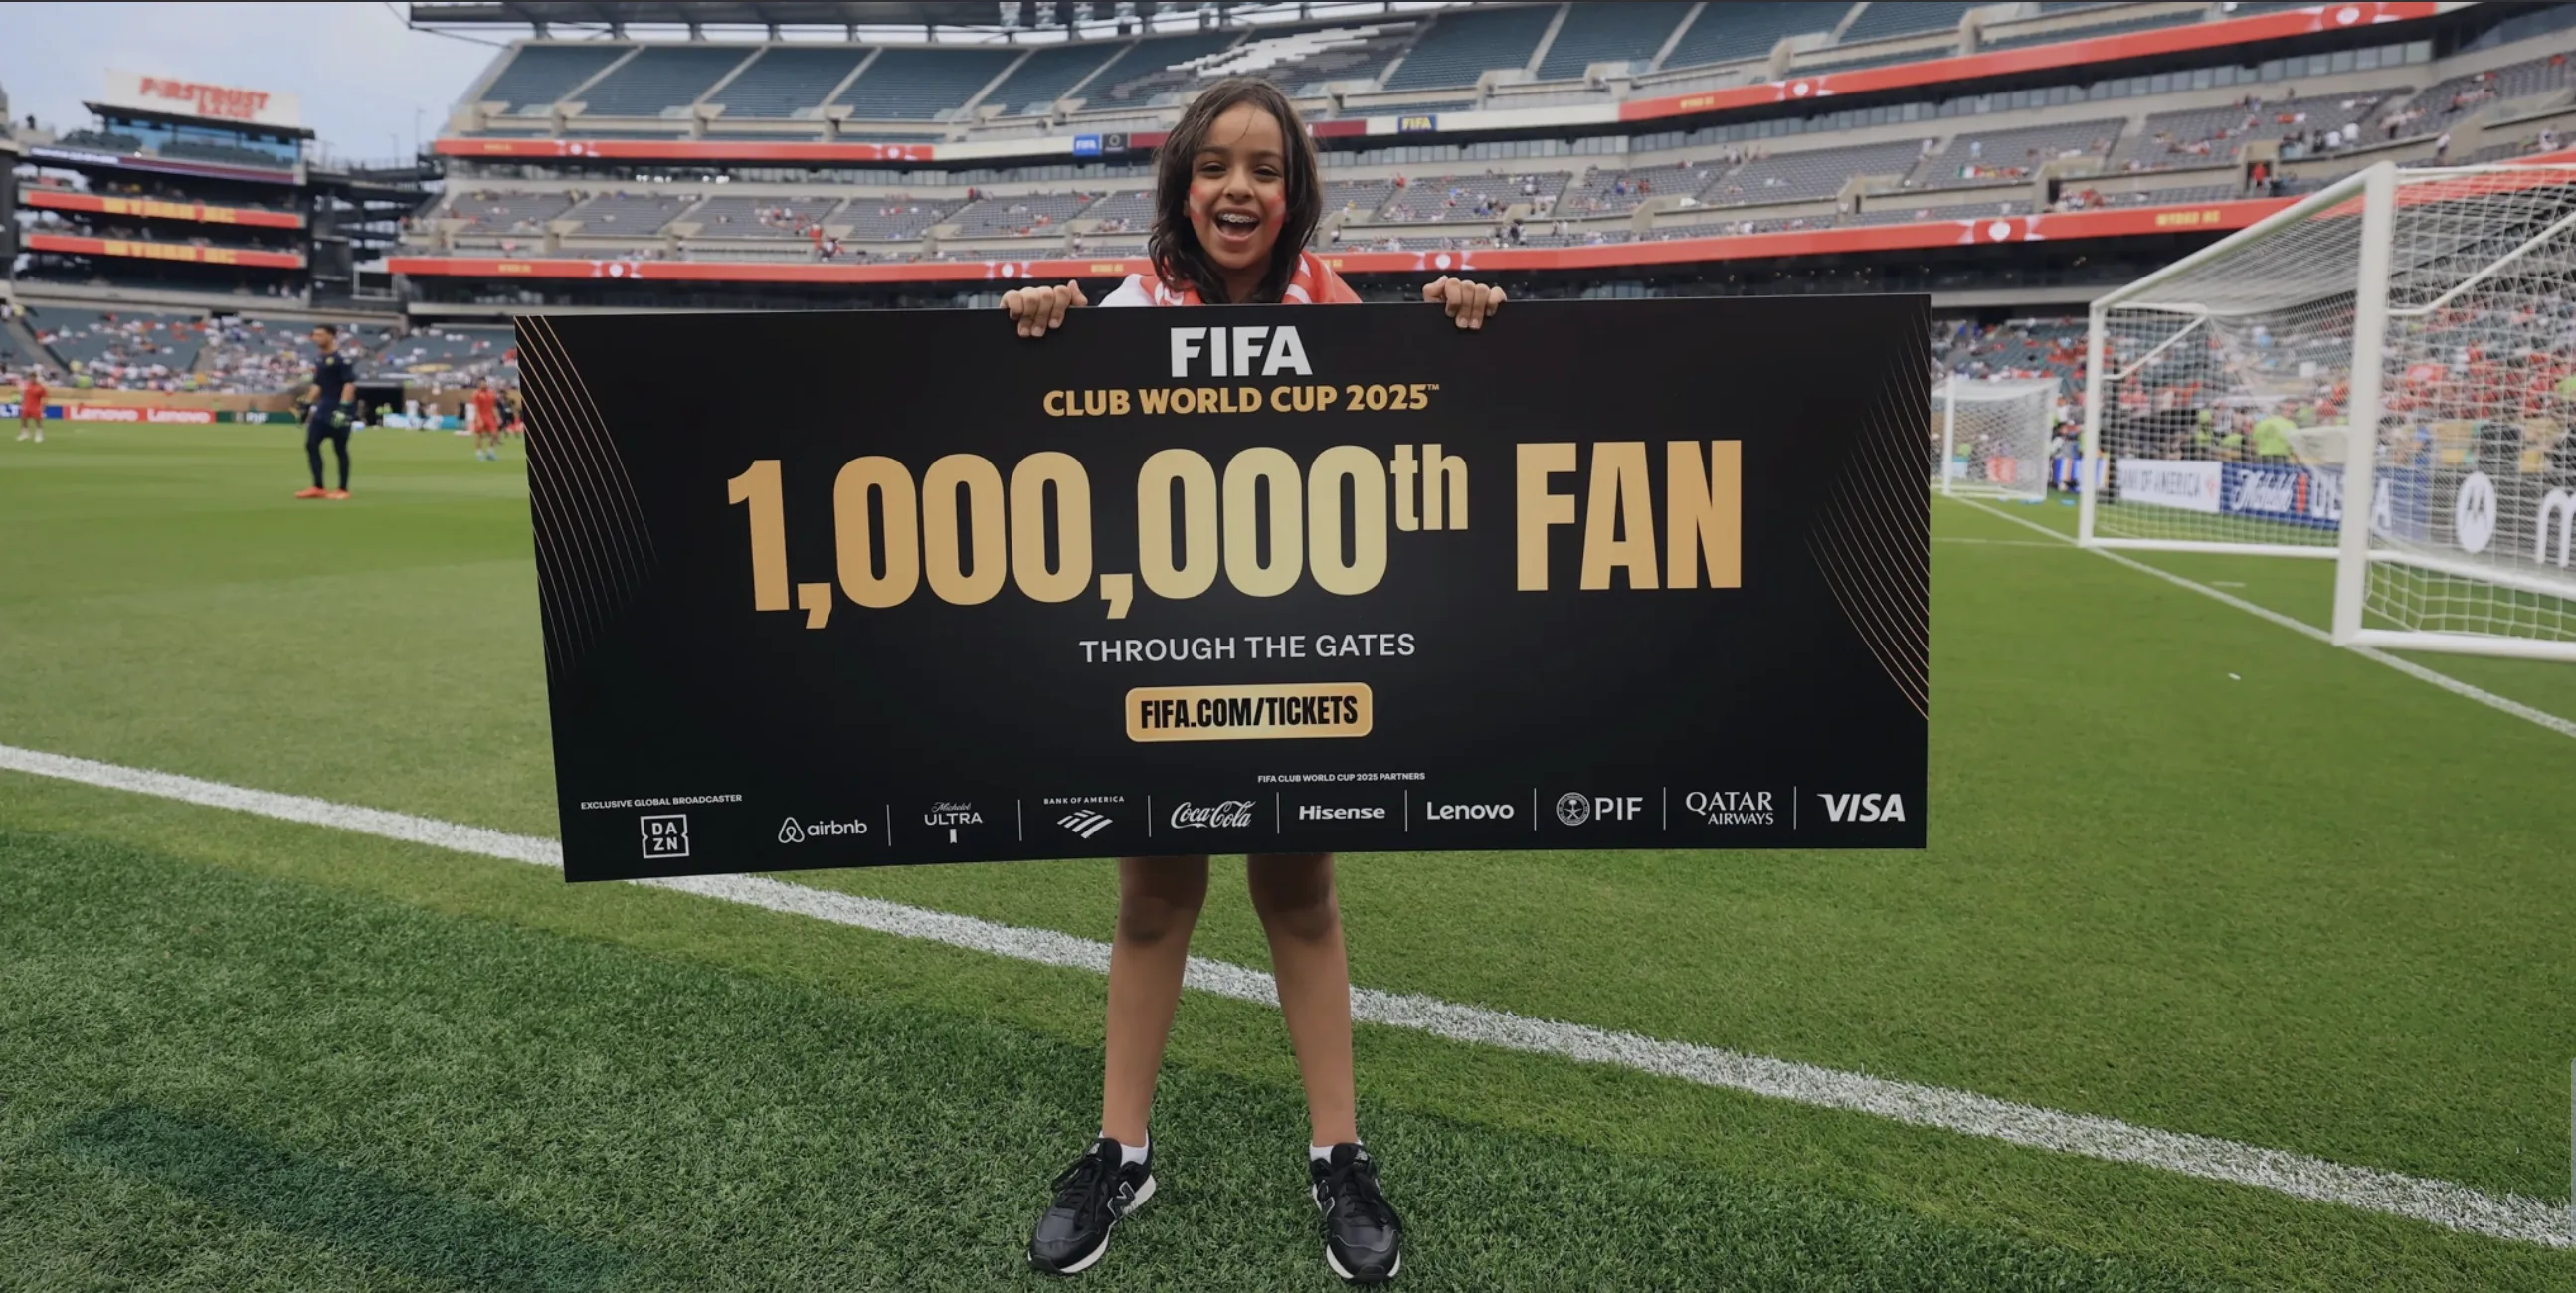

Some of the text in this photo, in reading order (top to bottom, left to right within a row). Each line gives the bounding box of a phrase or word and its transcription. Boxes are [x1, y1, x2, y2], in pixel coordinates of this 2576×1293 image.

[1402, 116, 1432, 131] FIFA
[1171, 326, 1313, 377] FIFA
[1043, 389, 1130, 416] CLUB
[1139, 387, 1262, 414] WORLD
[1270, 386, 1337, 412] CUP
[70, 406, 138, 421] Lenovo
[147, 408, 211, 423] Lenovo
[728, 440, 1742, 629] 1,000,000th FAN
[1079, 633, 1415, 662] THROUGH THE GATES
[1141, 696, 1358, 729] FIFA.COM/TICKETS
[1337, 773, 1356, 782] CUP
[1380, 772, 1426, 781] PARTNERS
[581, 795, 743, 810] EXCLUSIVE GLOBAL BROADCASTER
[1070, 796, 1082, 805] OF
[1595, 797, 1643, 821] PIF
[1685, 791, 1774, 816] QATAR
[1817, 793, 1906, 823] VISA
[924, 812, 983, 826] ULTRA
[1171, 800, 1256, 829] Coca-Cola
[1299, 805, 1386, 821] Hisense
[1427, 801, 1514, 821] Lenovo
[1708, 812, 1774, 825] AIRWAYS
[807, 820, 868, 836] airbnb
